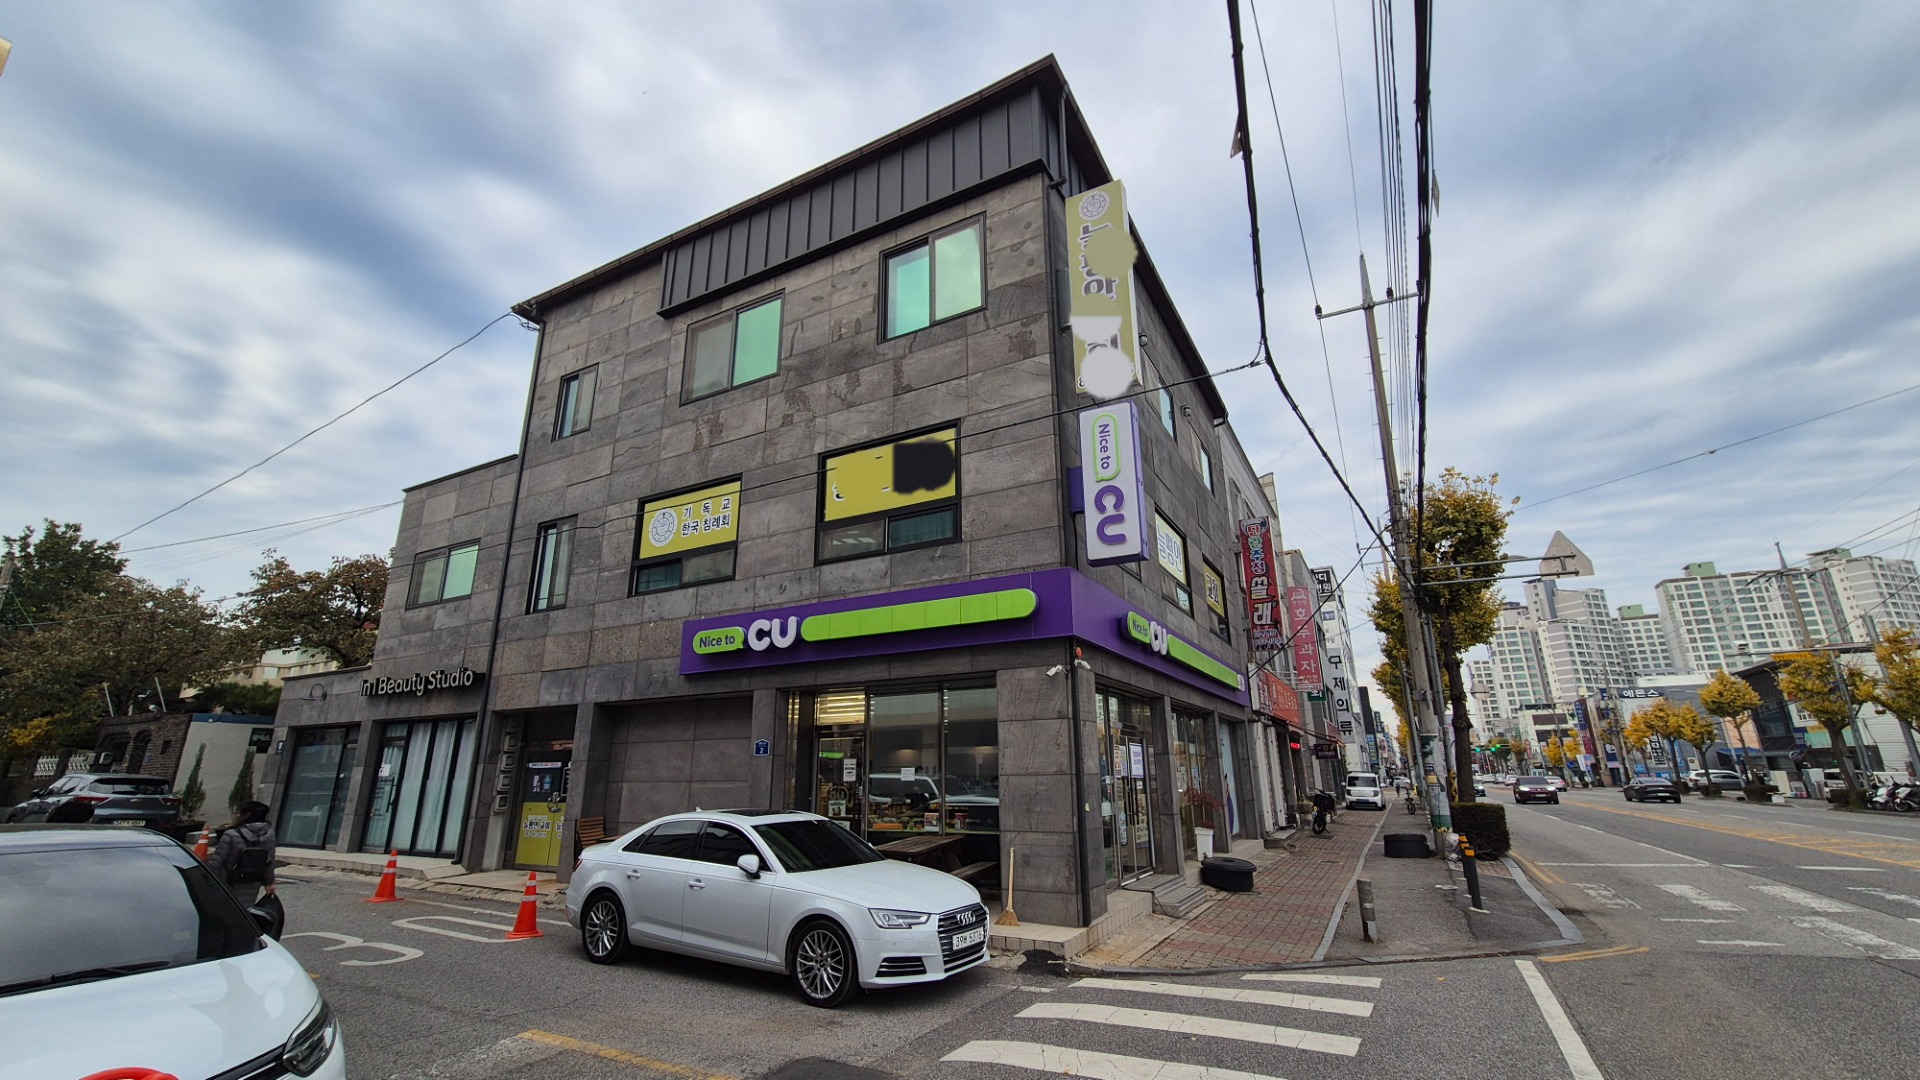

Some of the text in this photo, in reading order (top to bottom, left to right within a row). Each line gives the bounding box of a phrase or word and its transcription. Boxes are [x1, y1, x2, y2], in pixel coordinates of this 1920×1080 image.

[1098, 423, 1110, 470] Nice to
[682, 497, 732, 519] 기독교
[1094, 484, 1127, 545] CU
[681, 519, 700, 537] 한국
[702, 515, 731, 530] 침례회
[699, 617, 798, 651] Nice to CU
[1150, 620, 1168, 656] CU
[1294, 606, 1317, 673] 호두과자
[378, 672, 425, 697] Beauty
[427, 667, 474, 690] Studio
